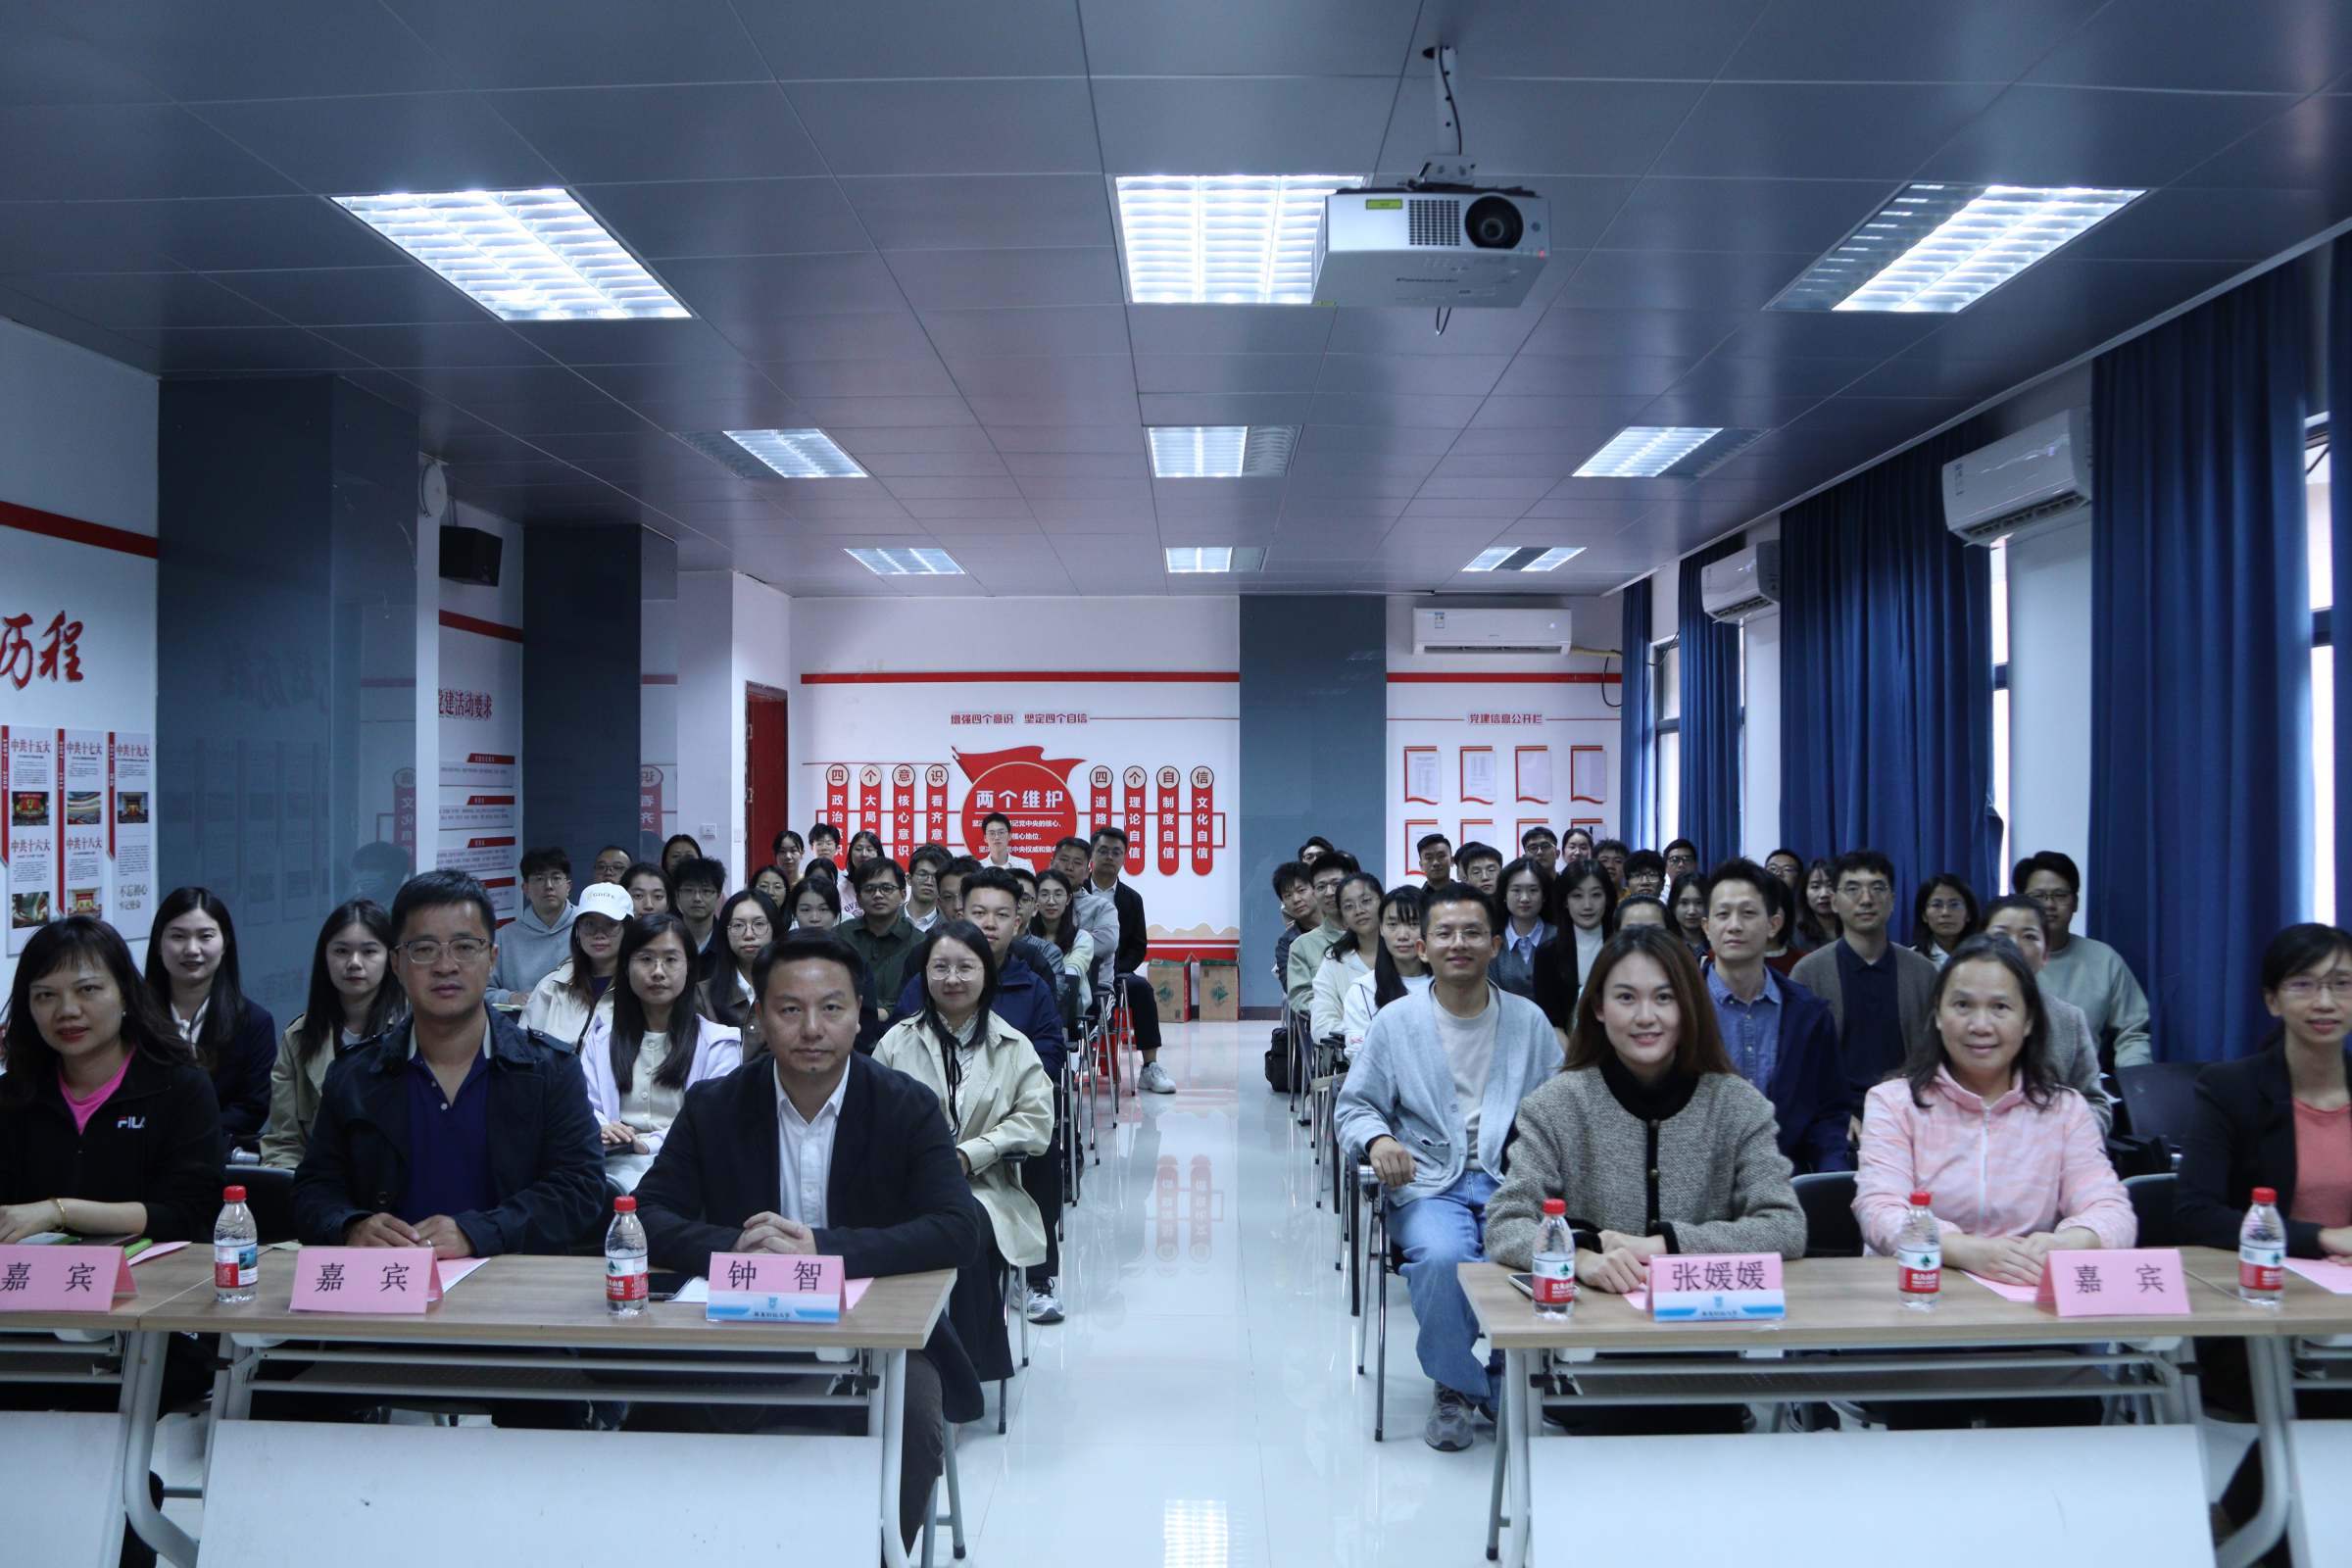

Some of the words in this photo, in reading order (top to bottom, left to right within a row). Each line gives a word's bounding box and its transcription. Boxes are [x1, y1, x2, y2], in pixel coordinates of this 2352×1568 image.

[0, 610, 84, 691] 历程
[951, 713, 1014, 724] 增强四个意识
[1024, 713, 1088, 724] 坚定四个自信
[1469, 713, 1543, 725] 党建信息公开栏
[11, 738, 51, 754] 中共十五大
[67, 740, 102, 756] 中共十七大
[976, 790, 1063, 808] 两个维护
[898, 796, 909, 857] 核心意识
[1129, 796, 1141, 859] 理论自信
[1162, 796, 1174, 859] 制度自信
[1197, 796, 1208, 859] 文化自信
[11, 838, 51, 854] 中共十六大
[67, 837, 102, 851] 中共十八大
[118, 1116, 146, 1128] FILA
[0, 1262, 96, 1292] 嘉宾
[315, 1262, 410, 1292] 嘉宾
[728, 1260, 821, 1291] 钟智
[1672, 1260, 1767, 1292] 张媛媛
[2074, 1263, 2165, 1294] 嘉宾
